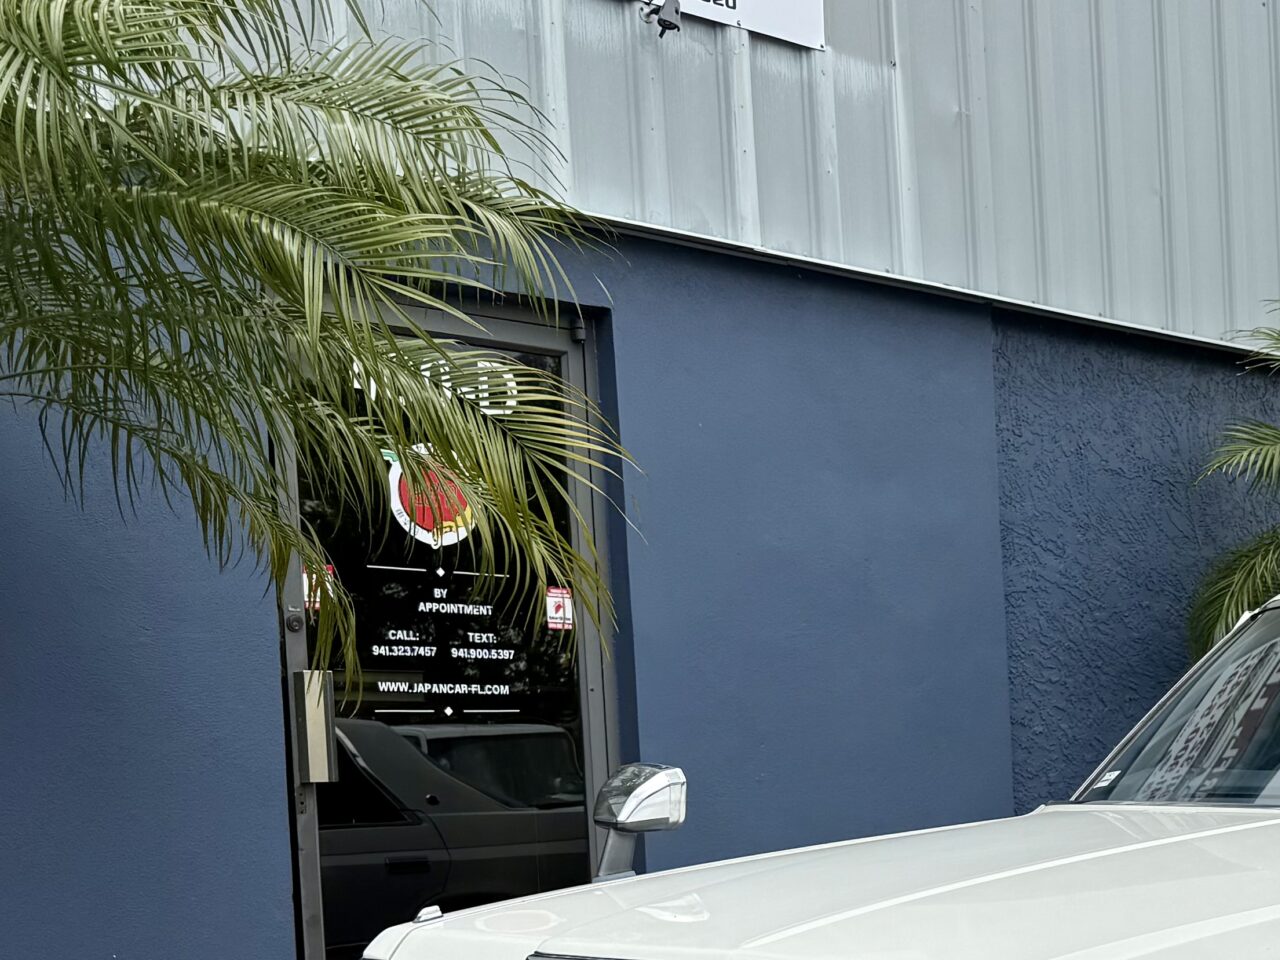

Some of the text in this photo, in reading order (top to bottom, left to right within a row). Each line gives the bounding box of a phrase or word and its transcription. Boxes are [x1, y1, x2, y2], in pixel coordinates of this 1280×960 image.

[433, 588, 448, 599] BY
[418, 602, 493, 616] APPOINTMENT
[388, 630, 420, 641] CALL:
[467, 632, 497, 644] TEXT:
[372, 645, 437, 657] 941.323.7457
[451, 648, 515, 660] 941.900.5397
[378, 681, 510, 695] WWW.JAPANCAR-FL.COM
